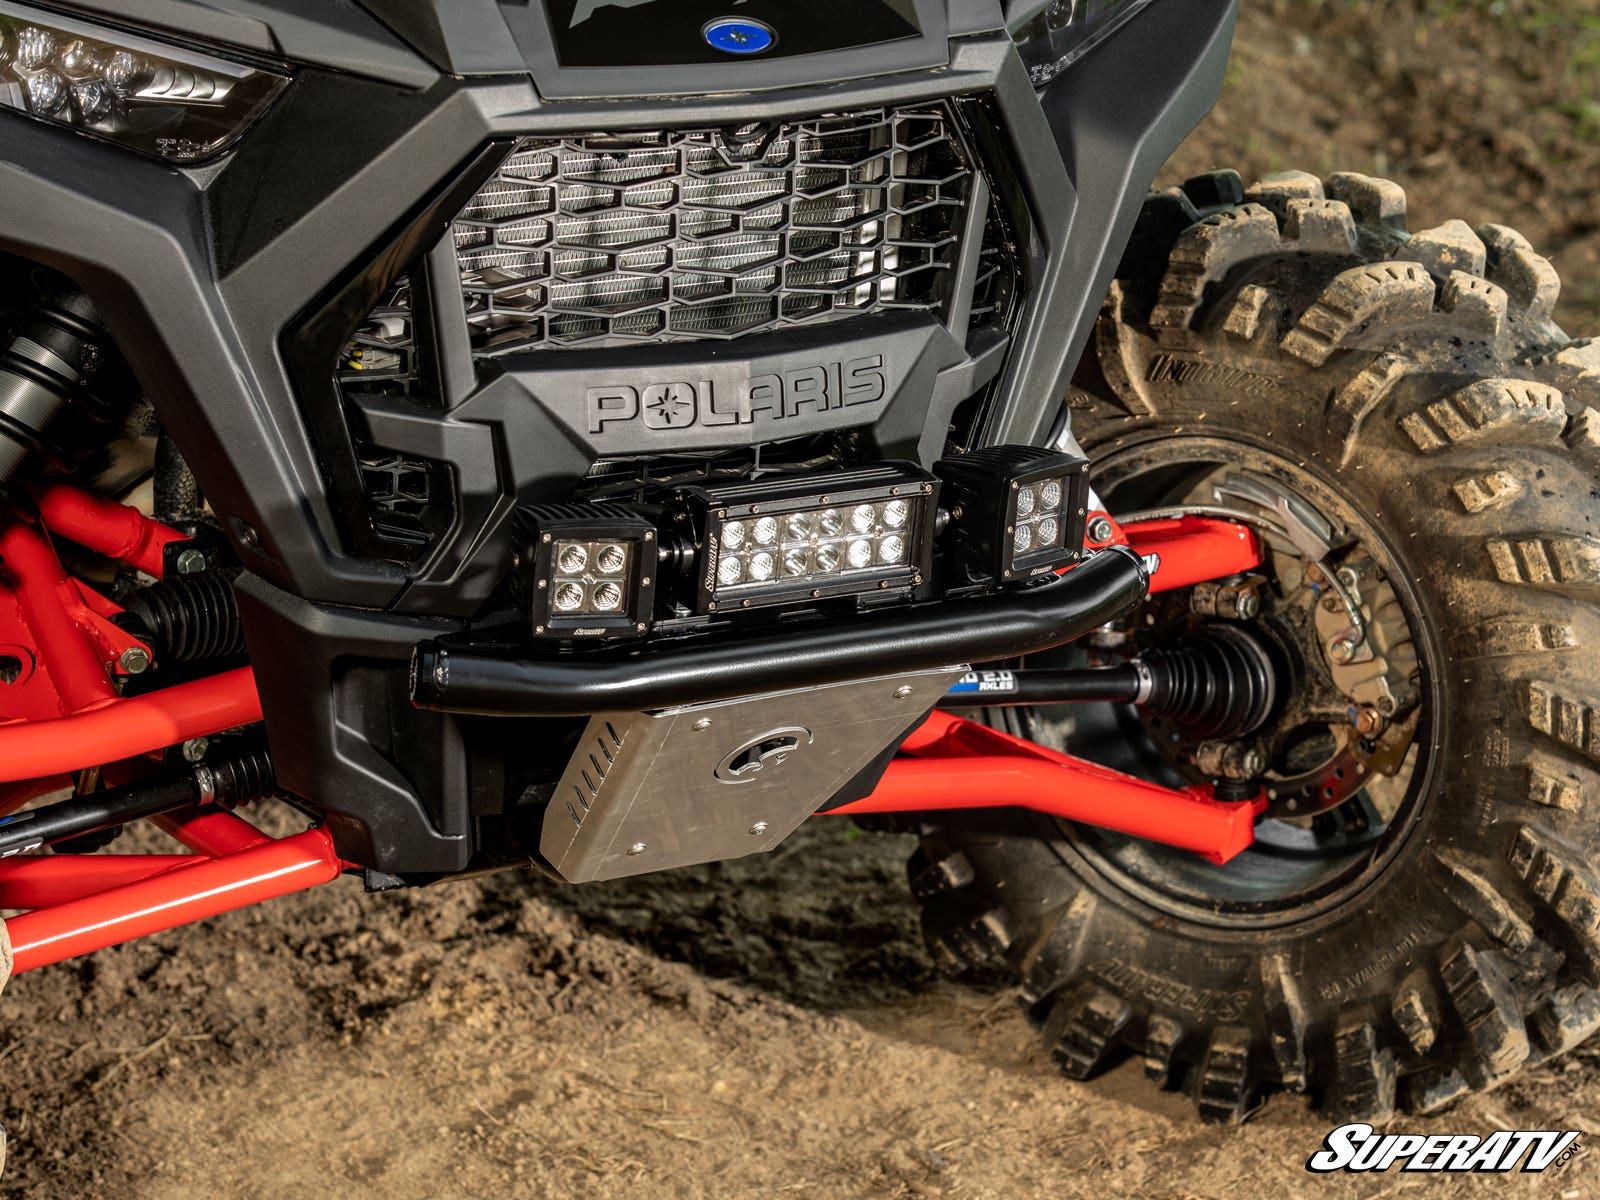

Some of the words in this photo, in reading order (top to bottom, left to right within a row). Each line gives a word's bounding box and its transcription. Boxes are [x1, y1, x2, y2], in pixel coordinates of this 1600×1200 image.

[587, 354, 886, 435] POLARIS
[980, 670, 1014, 682] 2.0
[979, 681, 1014, 691] AXLES
